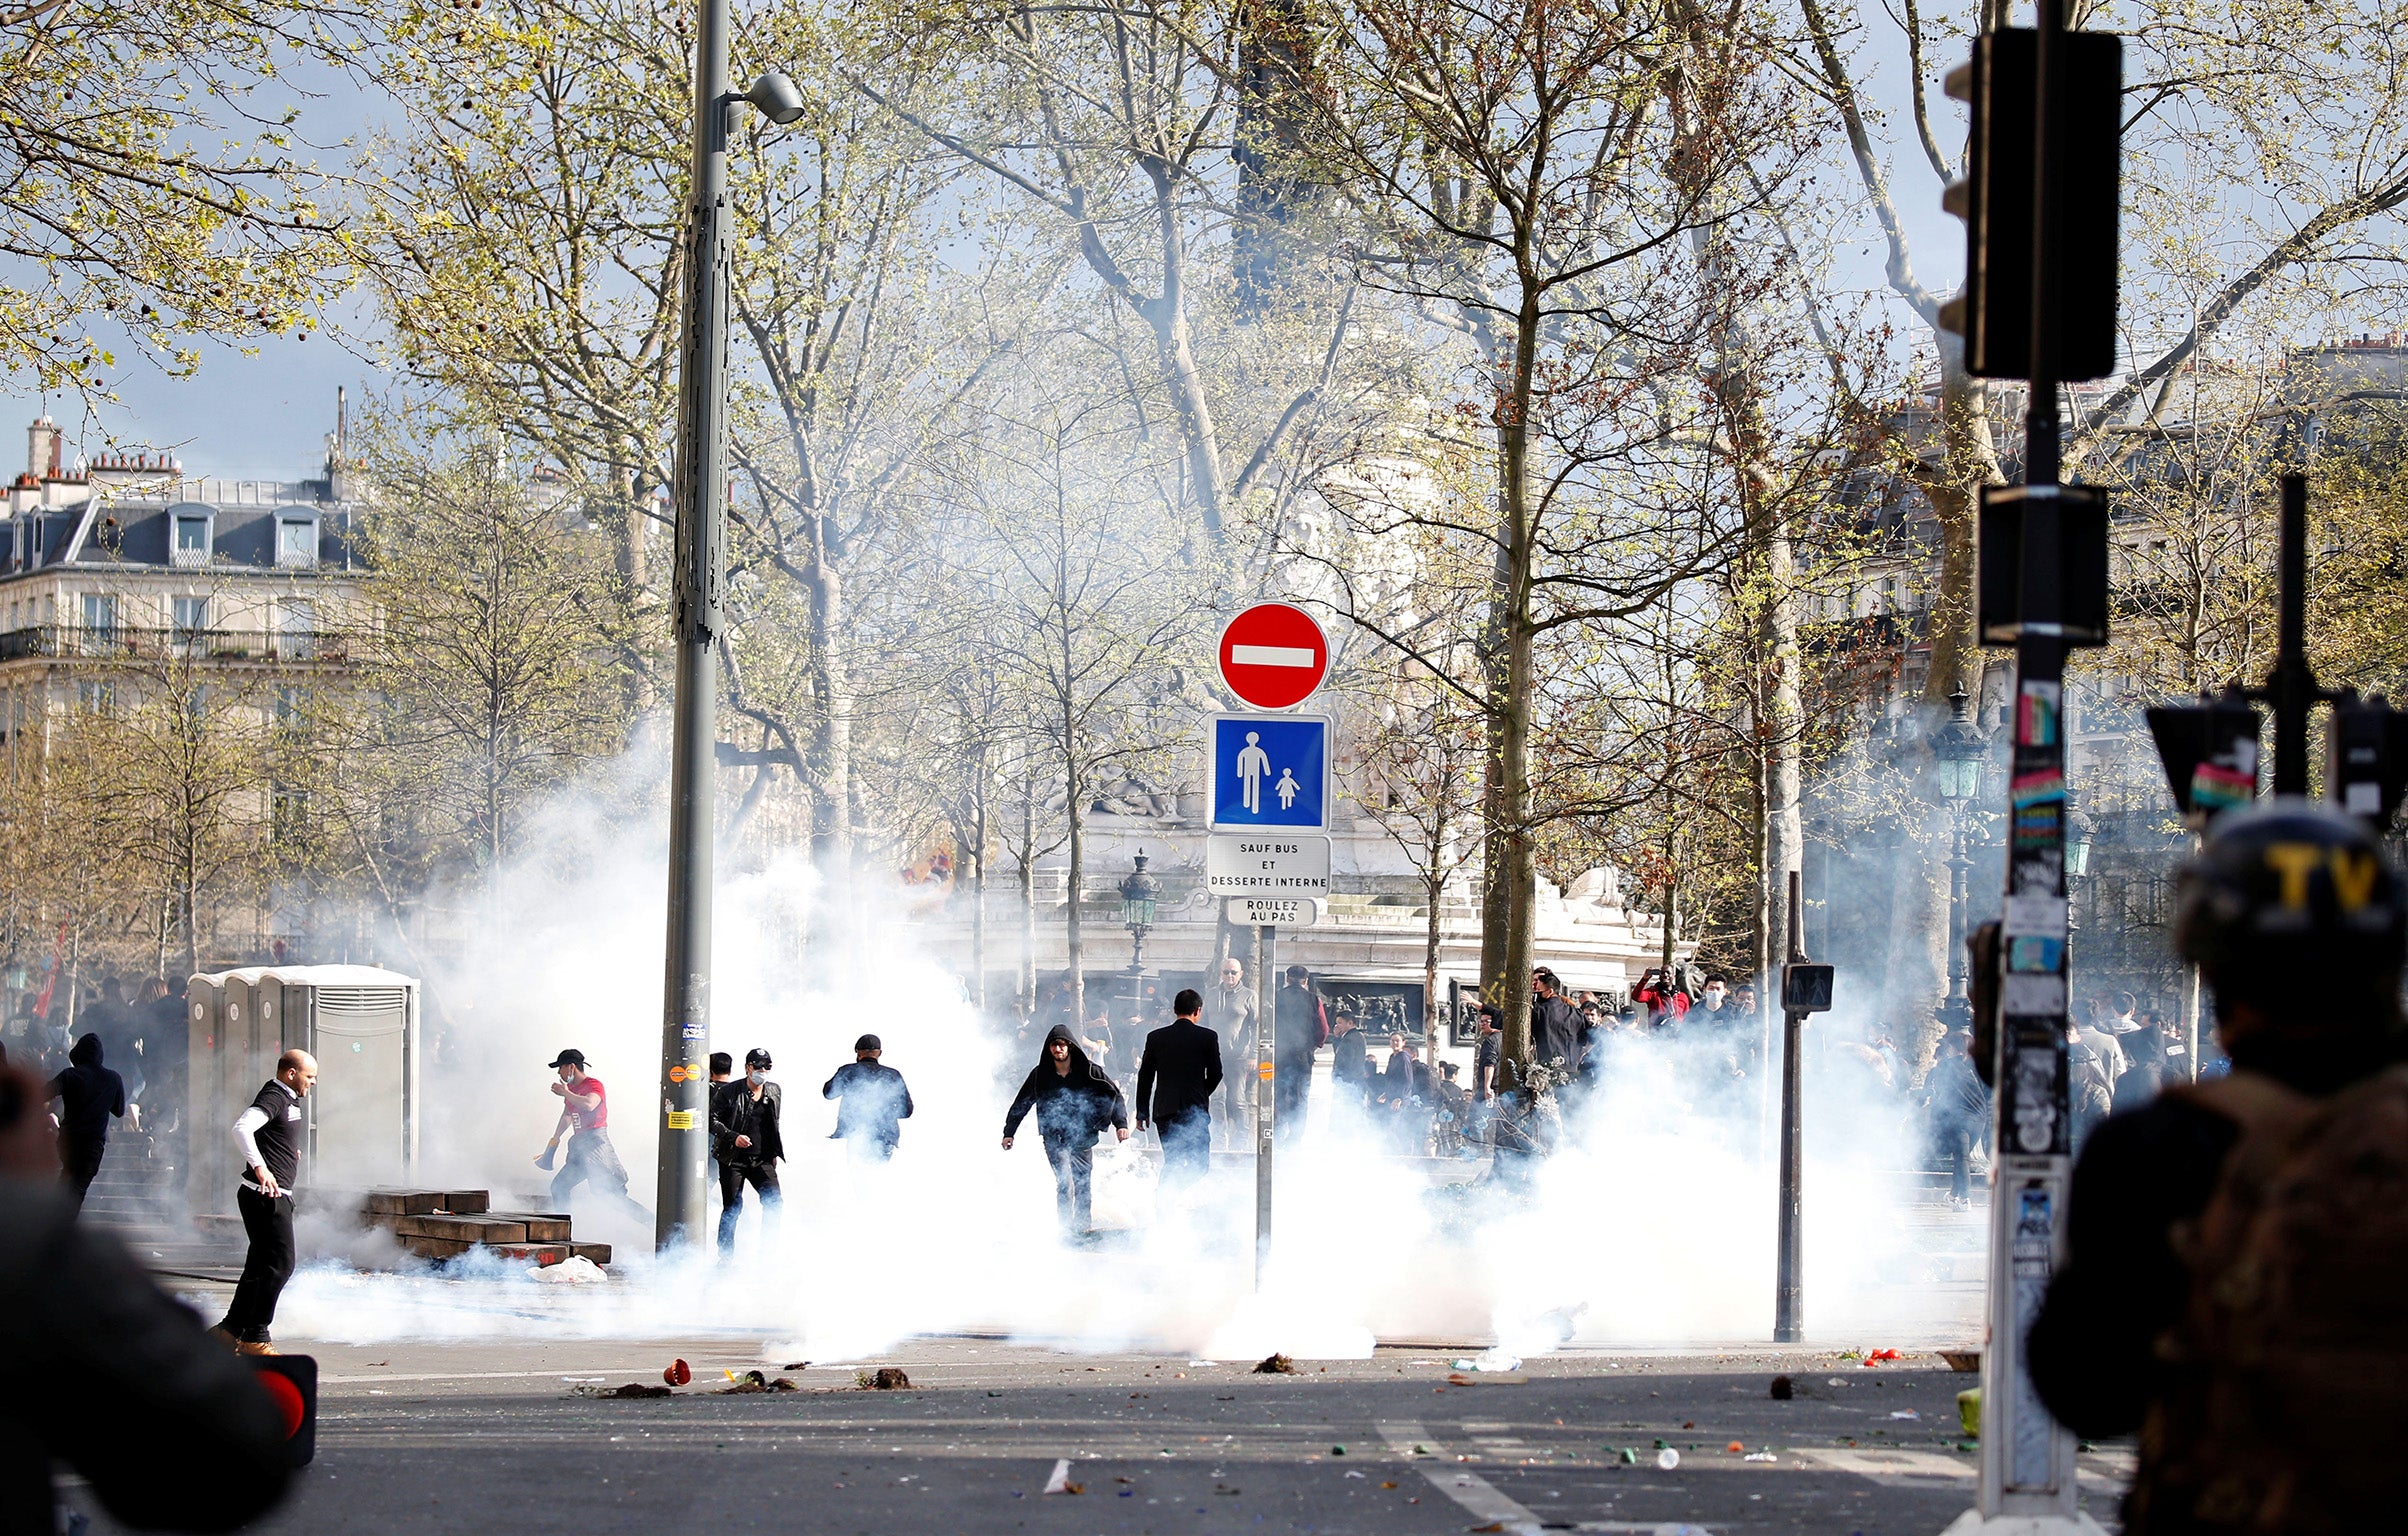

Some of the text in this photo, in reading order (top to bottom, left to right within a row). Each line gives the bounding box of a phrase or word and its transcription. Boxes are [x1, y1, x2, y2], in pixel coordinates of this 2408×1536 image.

[1240, 844, 1298, 854] SAUF BUS
[1262, 861, 1275, 869] ET
[1211, 877, 1327, 887] DESSERTE INTERNE
[2264, 842, 2378, 913] TV
[1247, 901, 1298, 911] ROULEZ
[1250, 912, 1295, 921] AU PAS
